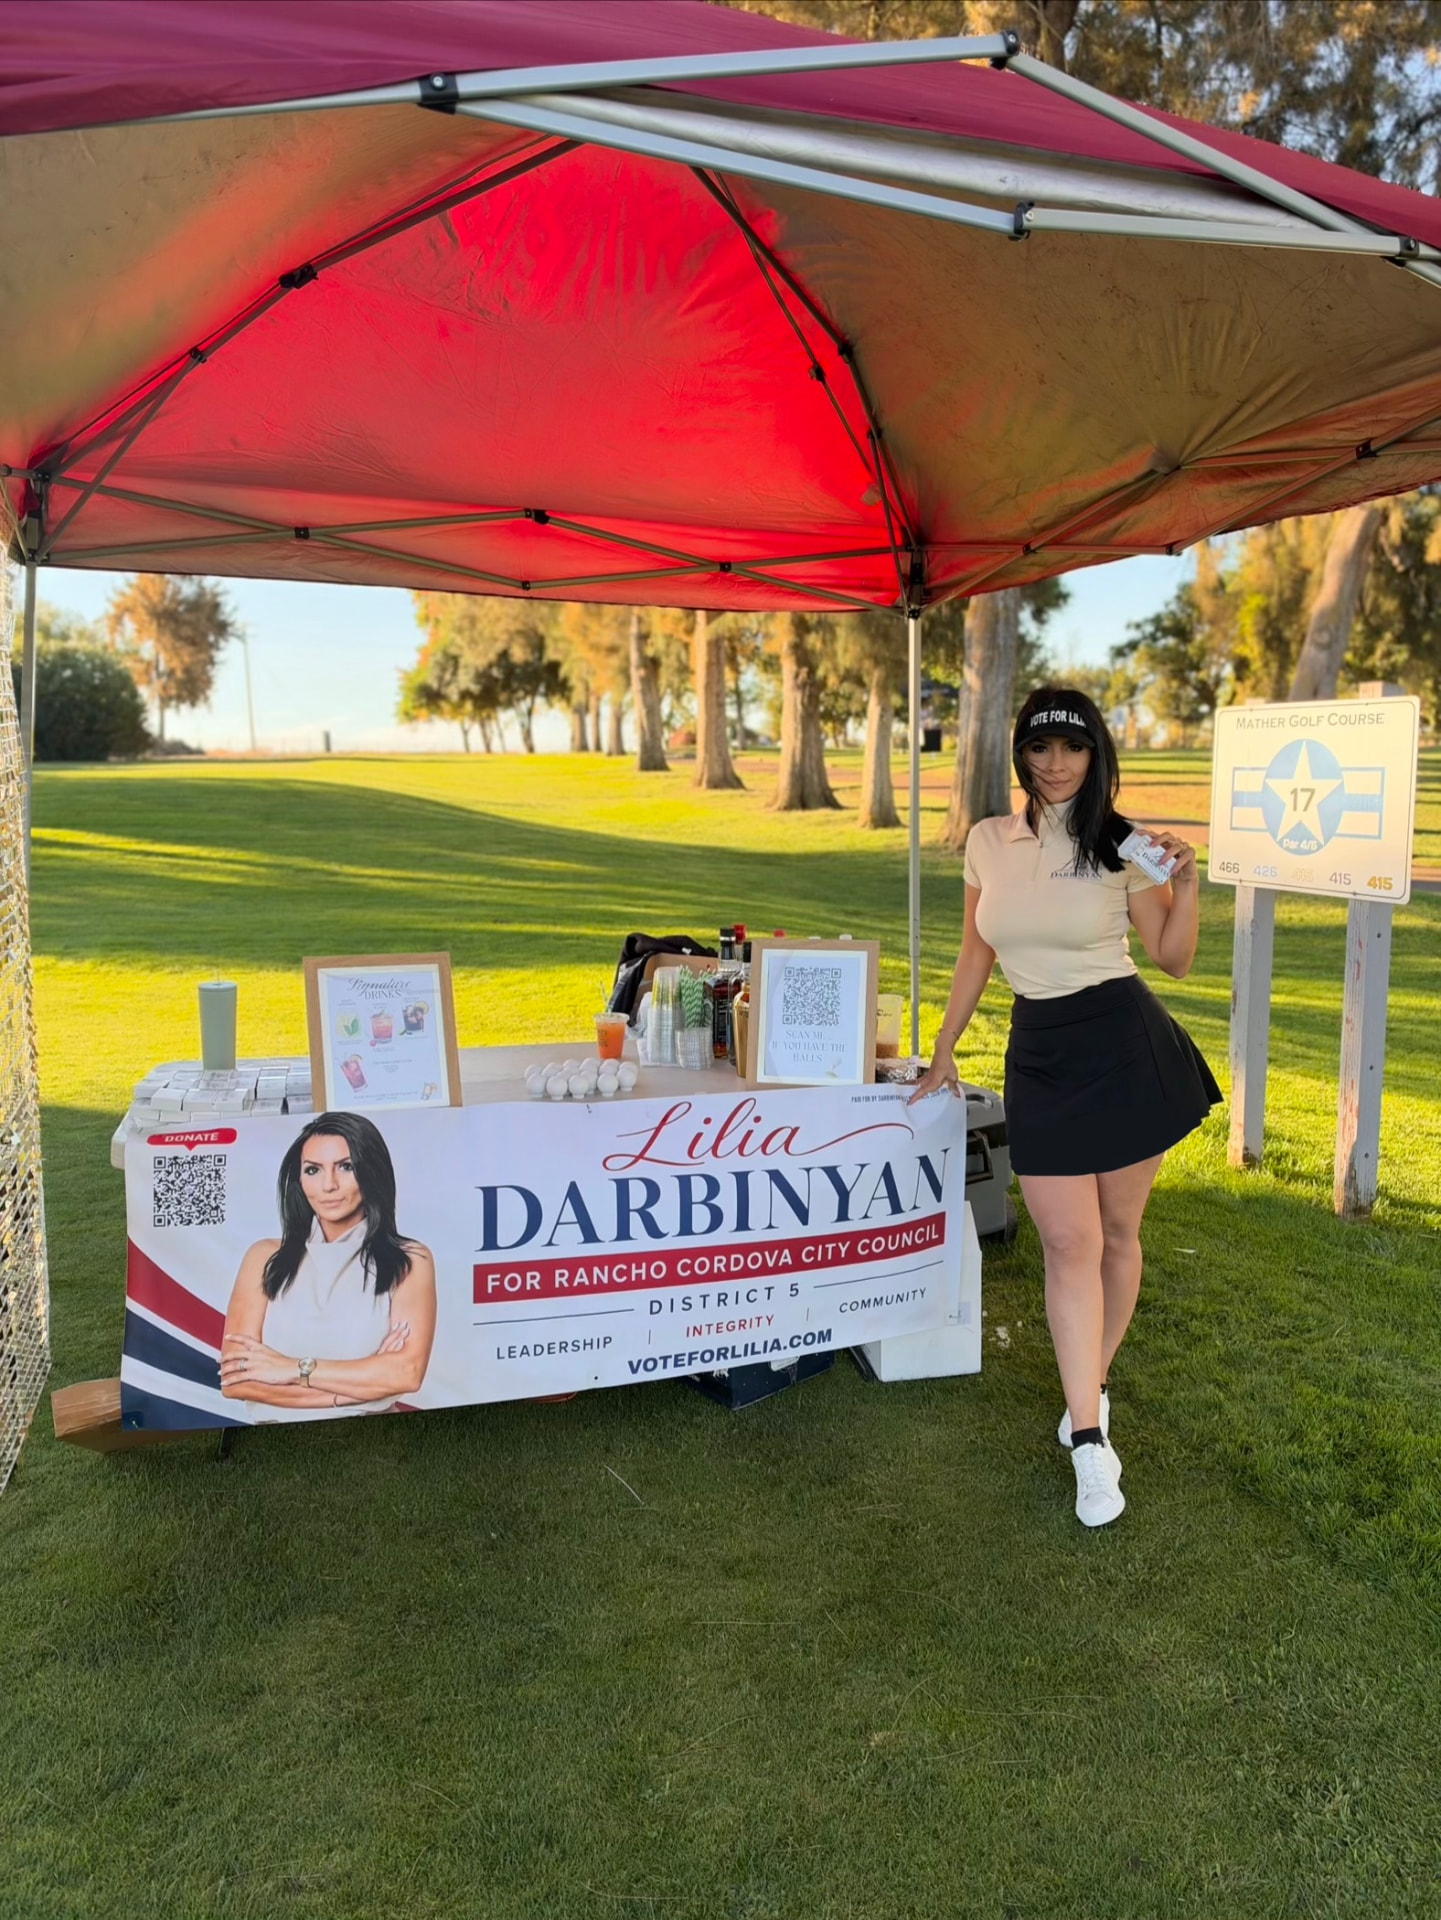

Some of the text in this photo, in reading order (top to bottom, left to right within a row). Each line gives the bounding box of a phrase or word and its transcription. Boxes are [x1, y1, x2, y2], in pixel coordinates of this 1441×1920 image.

[1049, 710, 1067, 723] FOR
[1236, 712, 1385, 730] MATHER GOLF COURSE
[1290, 787, 1316, 813] 17
[1283, 838, 1299, 849] Par
[1218, 861, 1240, 875] 466
[1252, 865, 1278, 878] 426
[1329, 871, 1352, 887] 415
[1366, 876, 1393, 891] 415
[347, 977, 412, 996] Signature
[364, 988, 402, 1000] DRINKS
[785, 1030, 811, 1040] SCAN
[783, 1041, 801, 1051] YOU
[803, 1042, 828, 1052] HAVE
[164, 1131, 220, 1144] DONATE
[602, 1097, 914, 1172] Lilia
[474, 1147, 951, 1252] DARBINYAN
[486, 1226, 940, 1295] FOR RANCHO CORDOVA CITY COUNCIL
[649, 1281, 801, 1316] DISTRICT 5
[496, 1287, 928, 1361] LEADERSHIP INTEGRITY COMMUNITY
[627, 1328, 833, 1376] VOTEFORLILIA.COM
